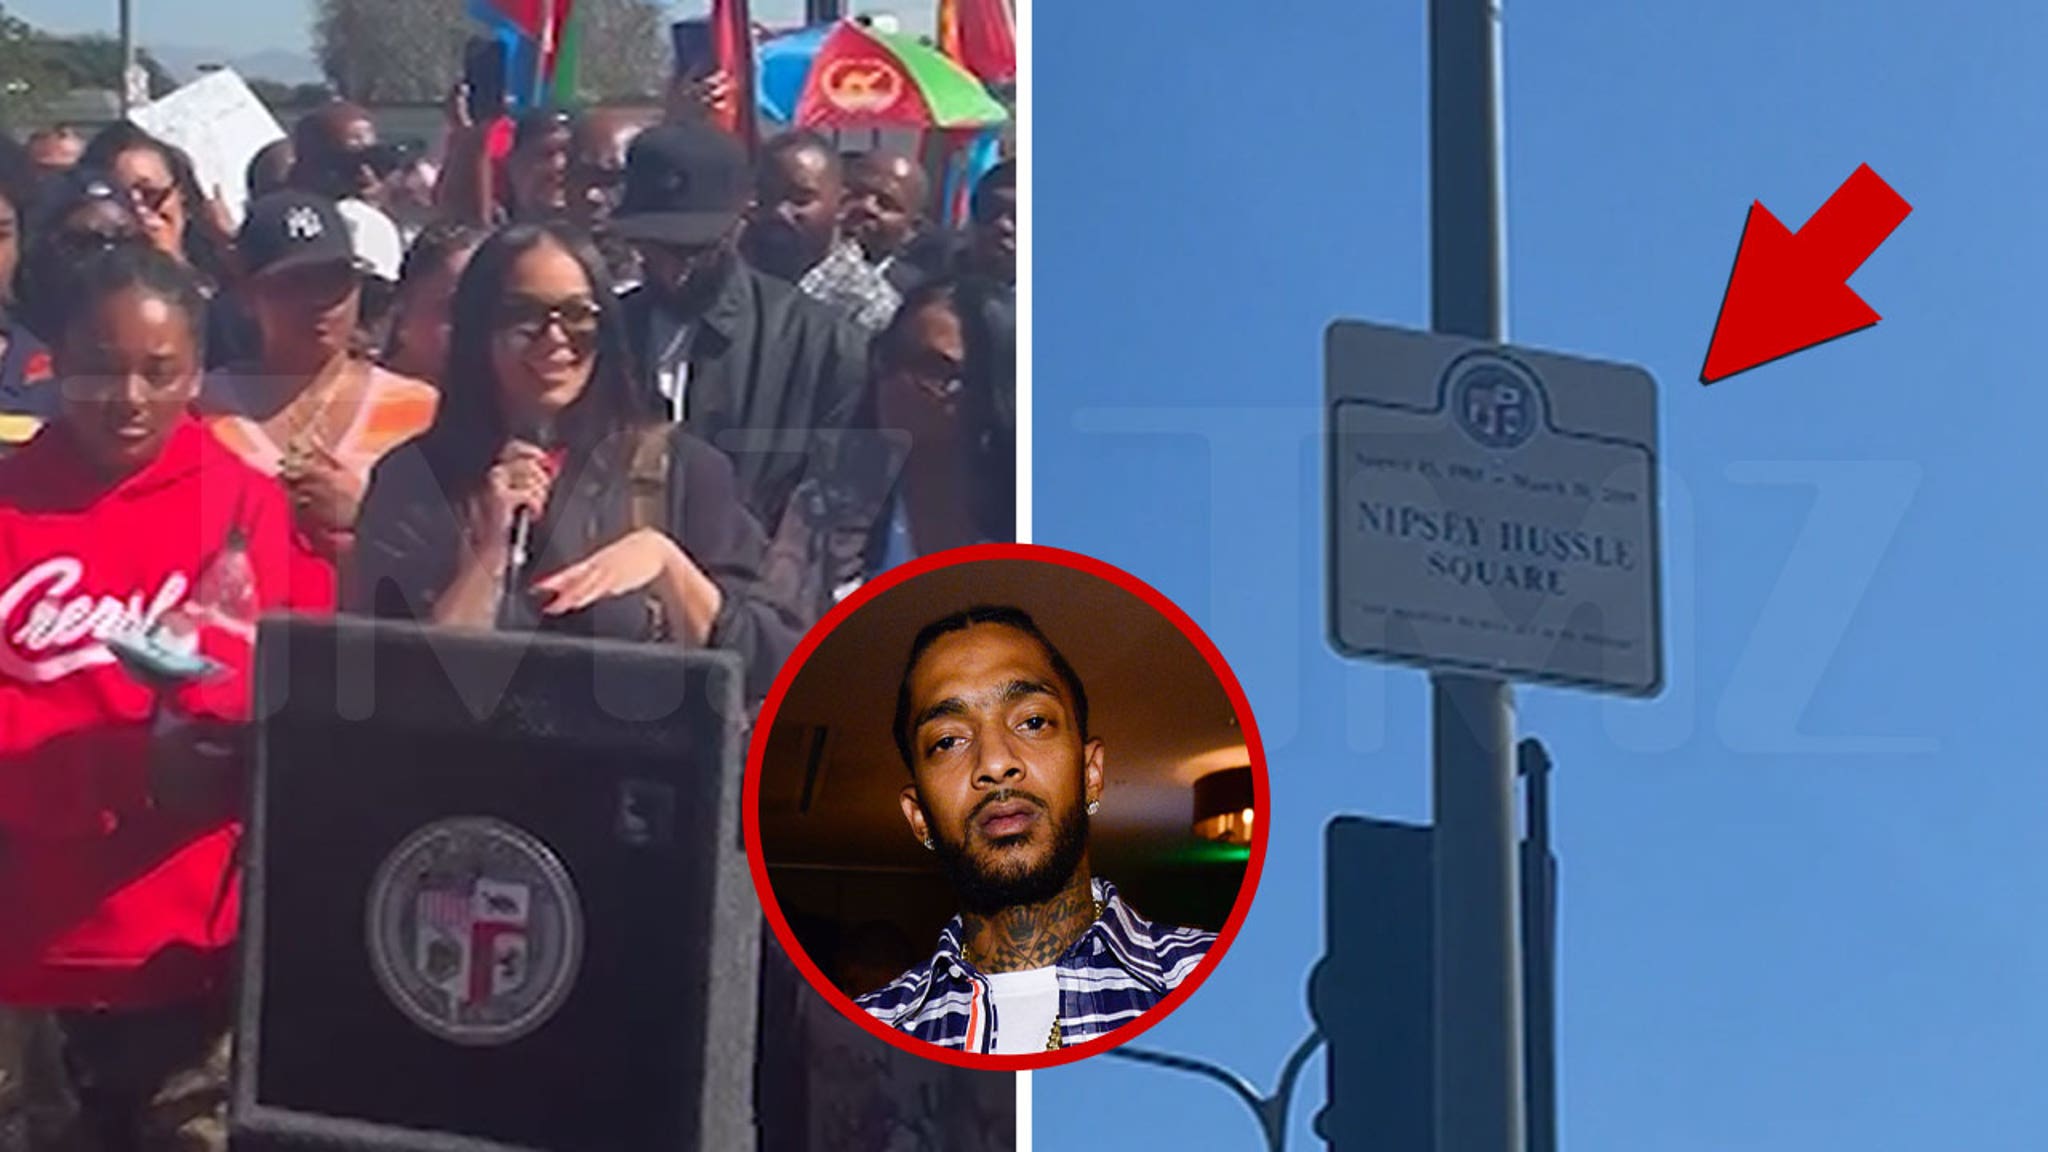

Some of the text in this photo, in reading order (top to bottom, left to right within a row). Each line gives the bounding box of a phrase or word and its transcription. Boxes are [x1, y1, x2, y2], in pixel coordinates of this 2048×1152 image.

[1358, 501, 1634, 571] NIPSEY HUSSLE
[1427, 551, 1566, 595] SQUARE
